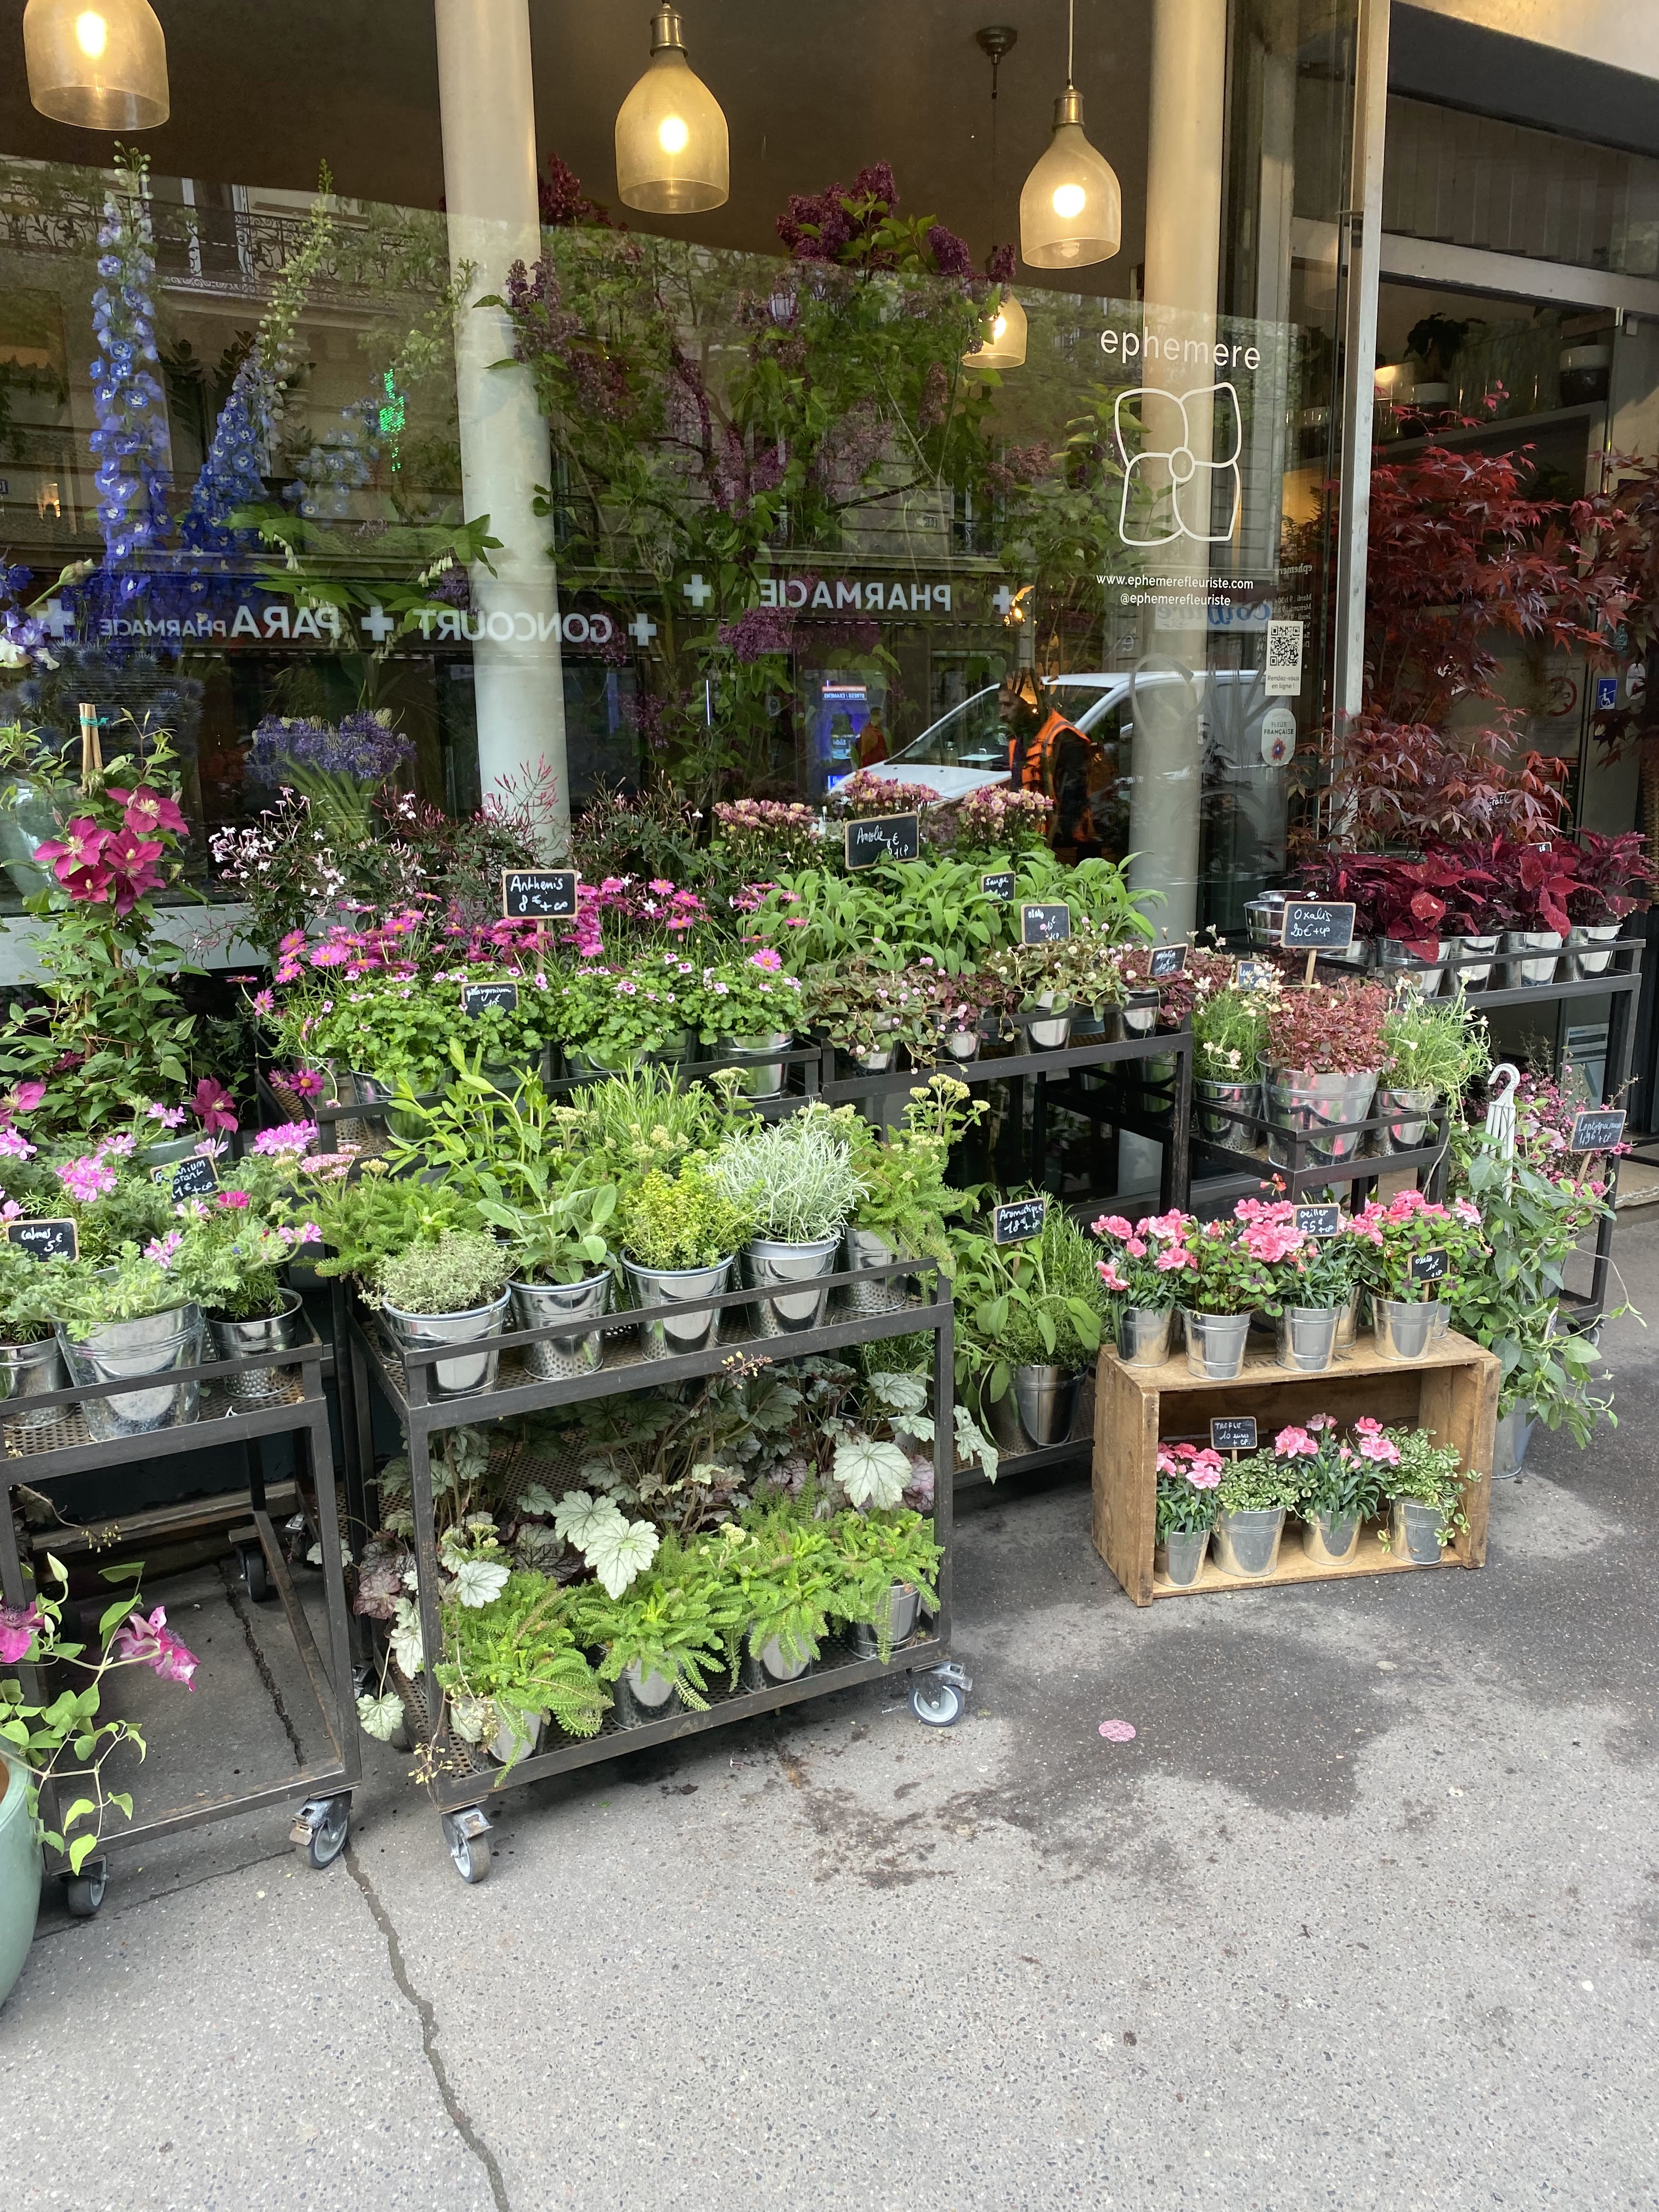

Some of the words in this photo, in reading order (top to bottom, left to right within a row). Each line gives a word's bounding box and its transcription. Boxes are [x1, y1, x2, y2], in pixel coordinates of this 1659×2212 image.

[1101, 326, 1261, 370] ephemere
[1096, 574, 1254, 590] www.ephemerefleuriste.com
[1120, 593, 1231, 606] @ephemerefleuriste
[1294, 907, 1333, 922] Oxalis
